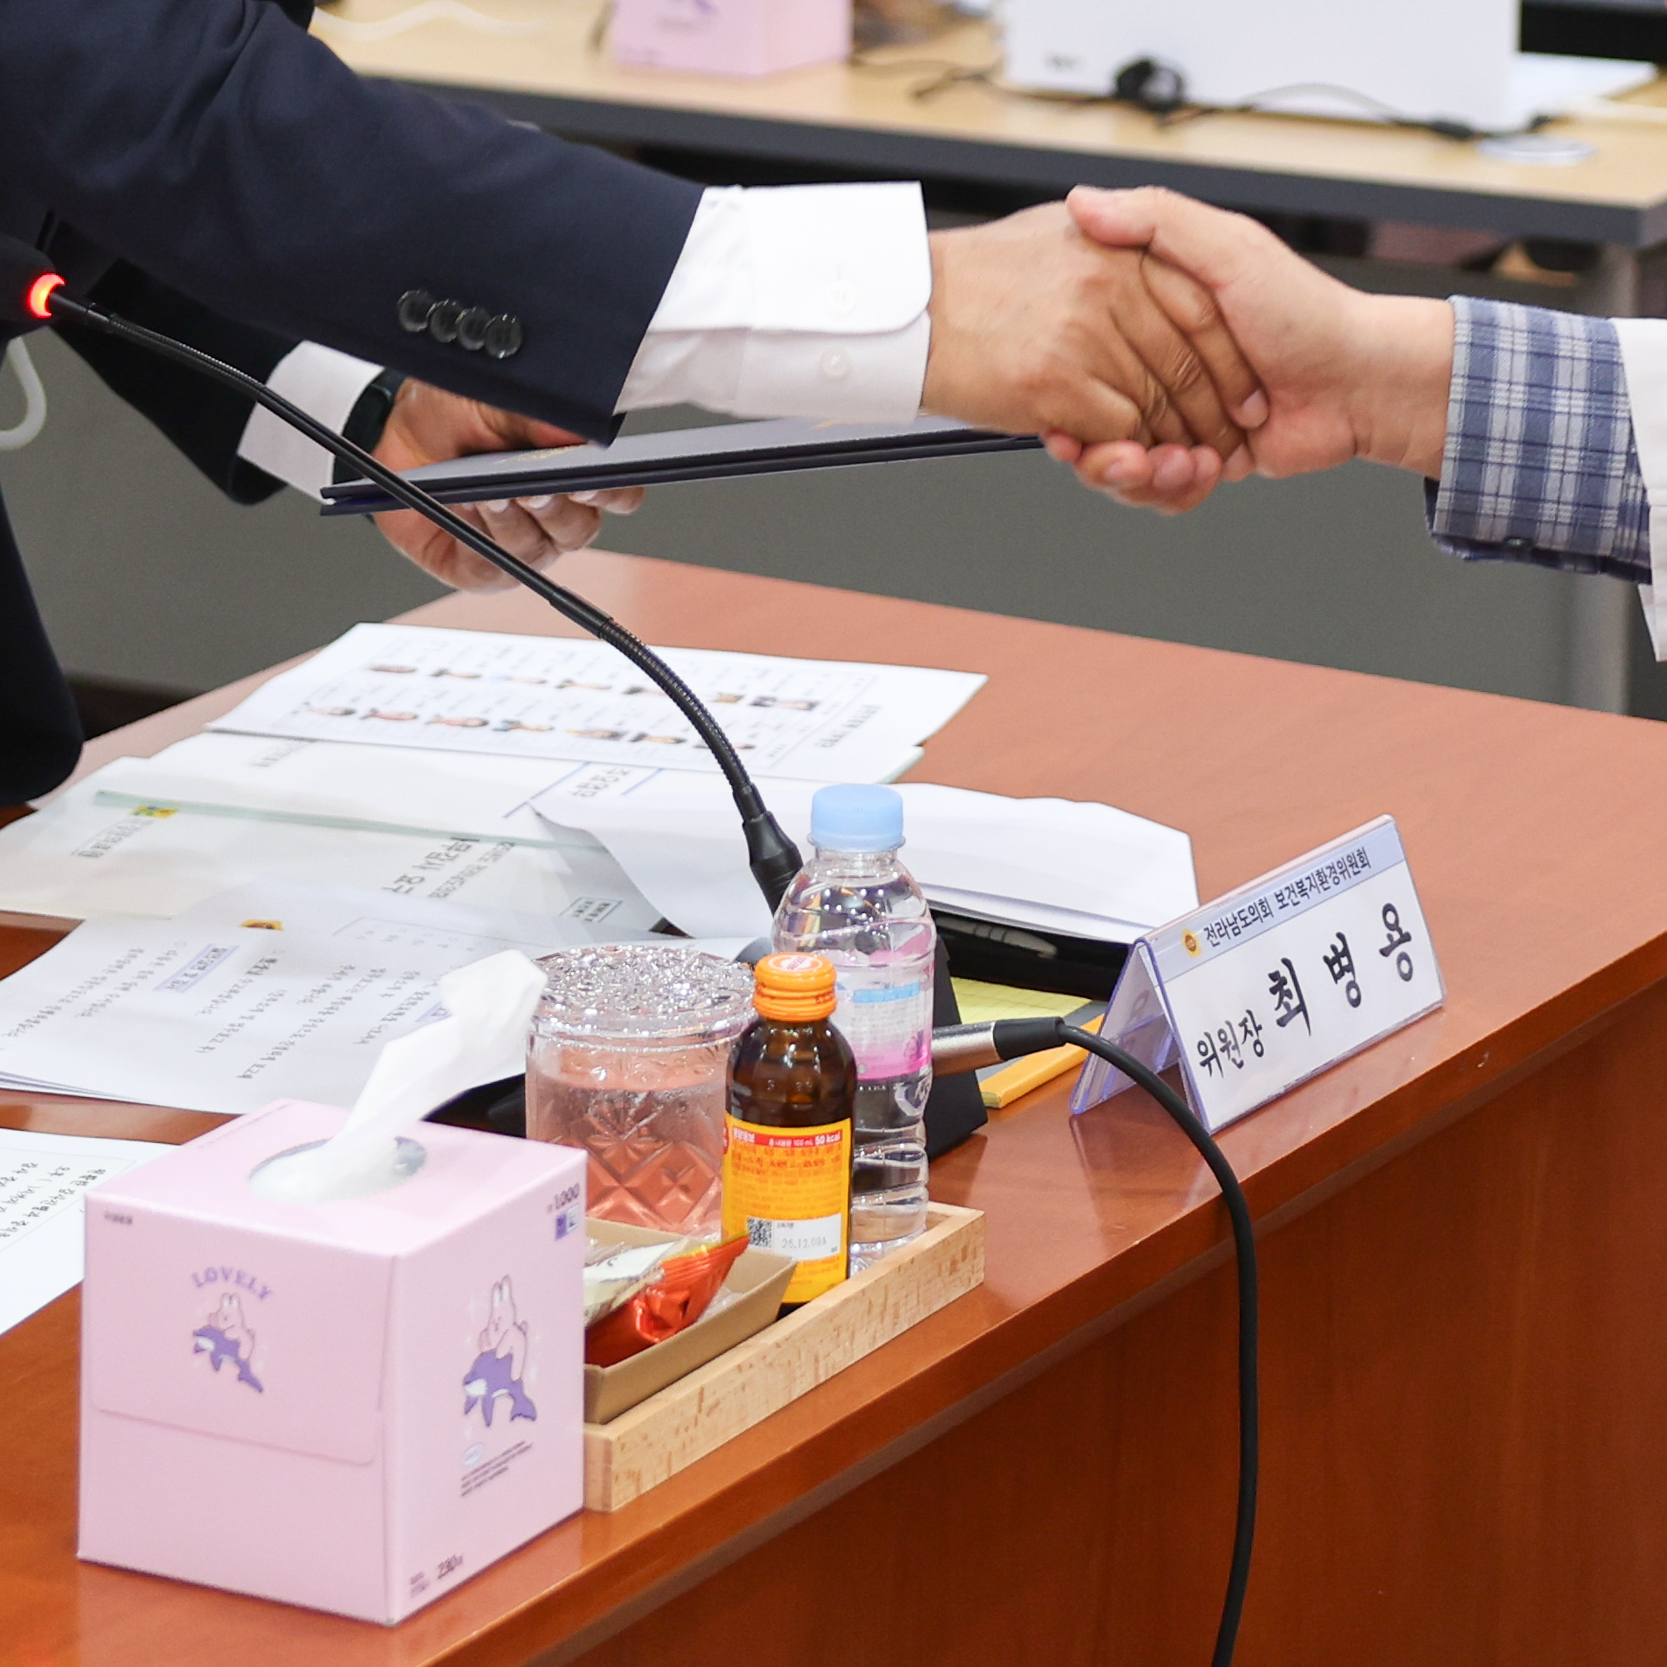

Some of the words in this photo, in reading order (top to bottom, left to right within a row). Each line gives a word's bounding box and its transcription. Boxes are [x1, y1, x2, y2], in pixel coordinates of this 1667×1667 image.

[1204, 897, 1272, 949] 전라남도의회
[1273, 845, 1372, 911] 보건복지환경위원회
[1196, 1008, 1264, 1079] 위원장
[815, 1134, 825, 1145] 50
[826, 1131, 841, 1144] kcal
[12, 1162, 39, 1175] 감사
[192, 1266, 274, 1300] LOVELY
